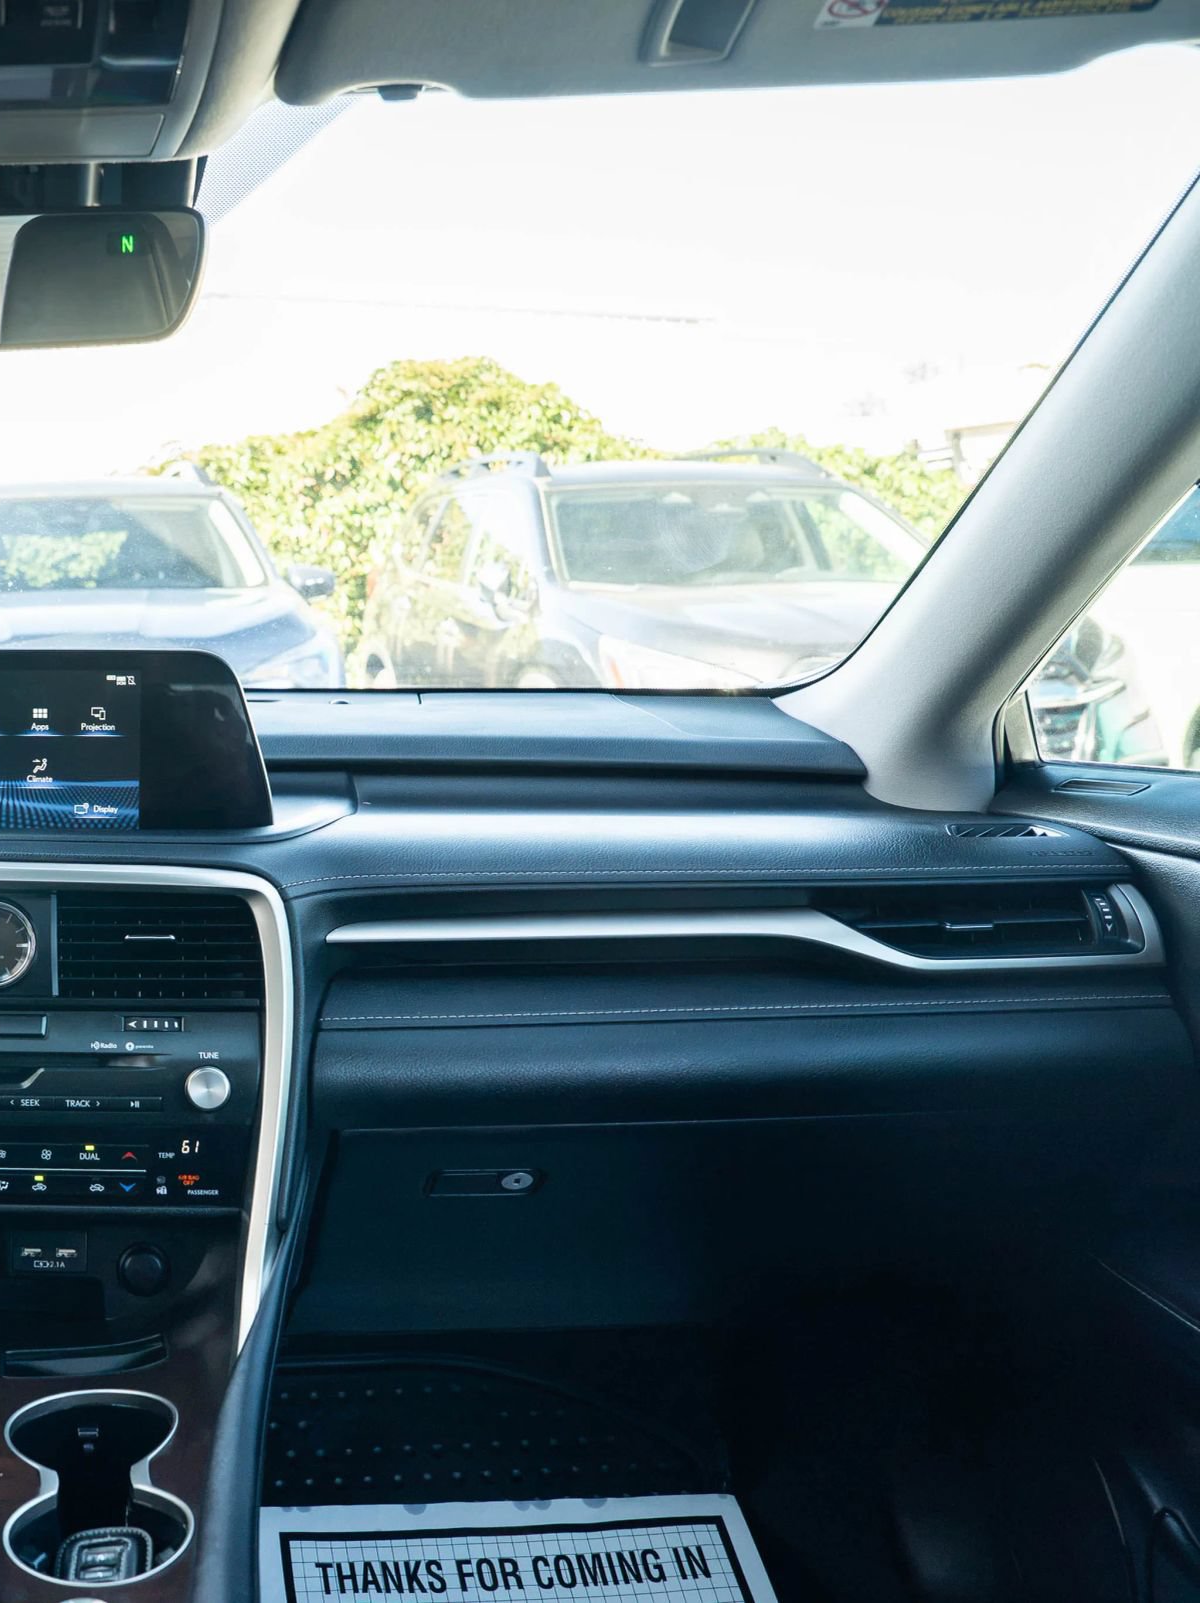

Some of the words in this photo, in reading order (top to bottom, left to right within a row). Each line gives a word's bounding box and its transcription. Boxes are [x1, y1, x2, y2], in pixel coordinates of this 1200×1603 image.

[121, 234, 134, 253] N
[31, 723, 49, 732] Apps
[81, 722, 116, 732] Projection
[26, 774, 53, 783] Climate
[93, 804, 119, 815] Display
[198, 1051, 220, 1060] TUNE
[20, 1099, 40, 1107] SEEK
[65, 1100, 90, 1108] TRACK
[181, 1139, 200, 1154] 61
[79, 1152, 100, 1160] DUAL
[315, 1559, 448, 1594] THANKS
[457, 1557, 525, 1592] FOR
[531, 1548, 668, 1589] COMING
[672, 1544, 712, 1579] IN
